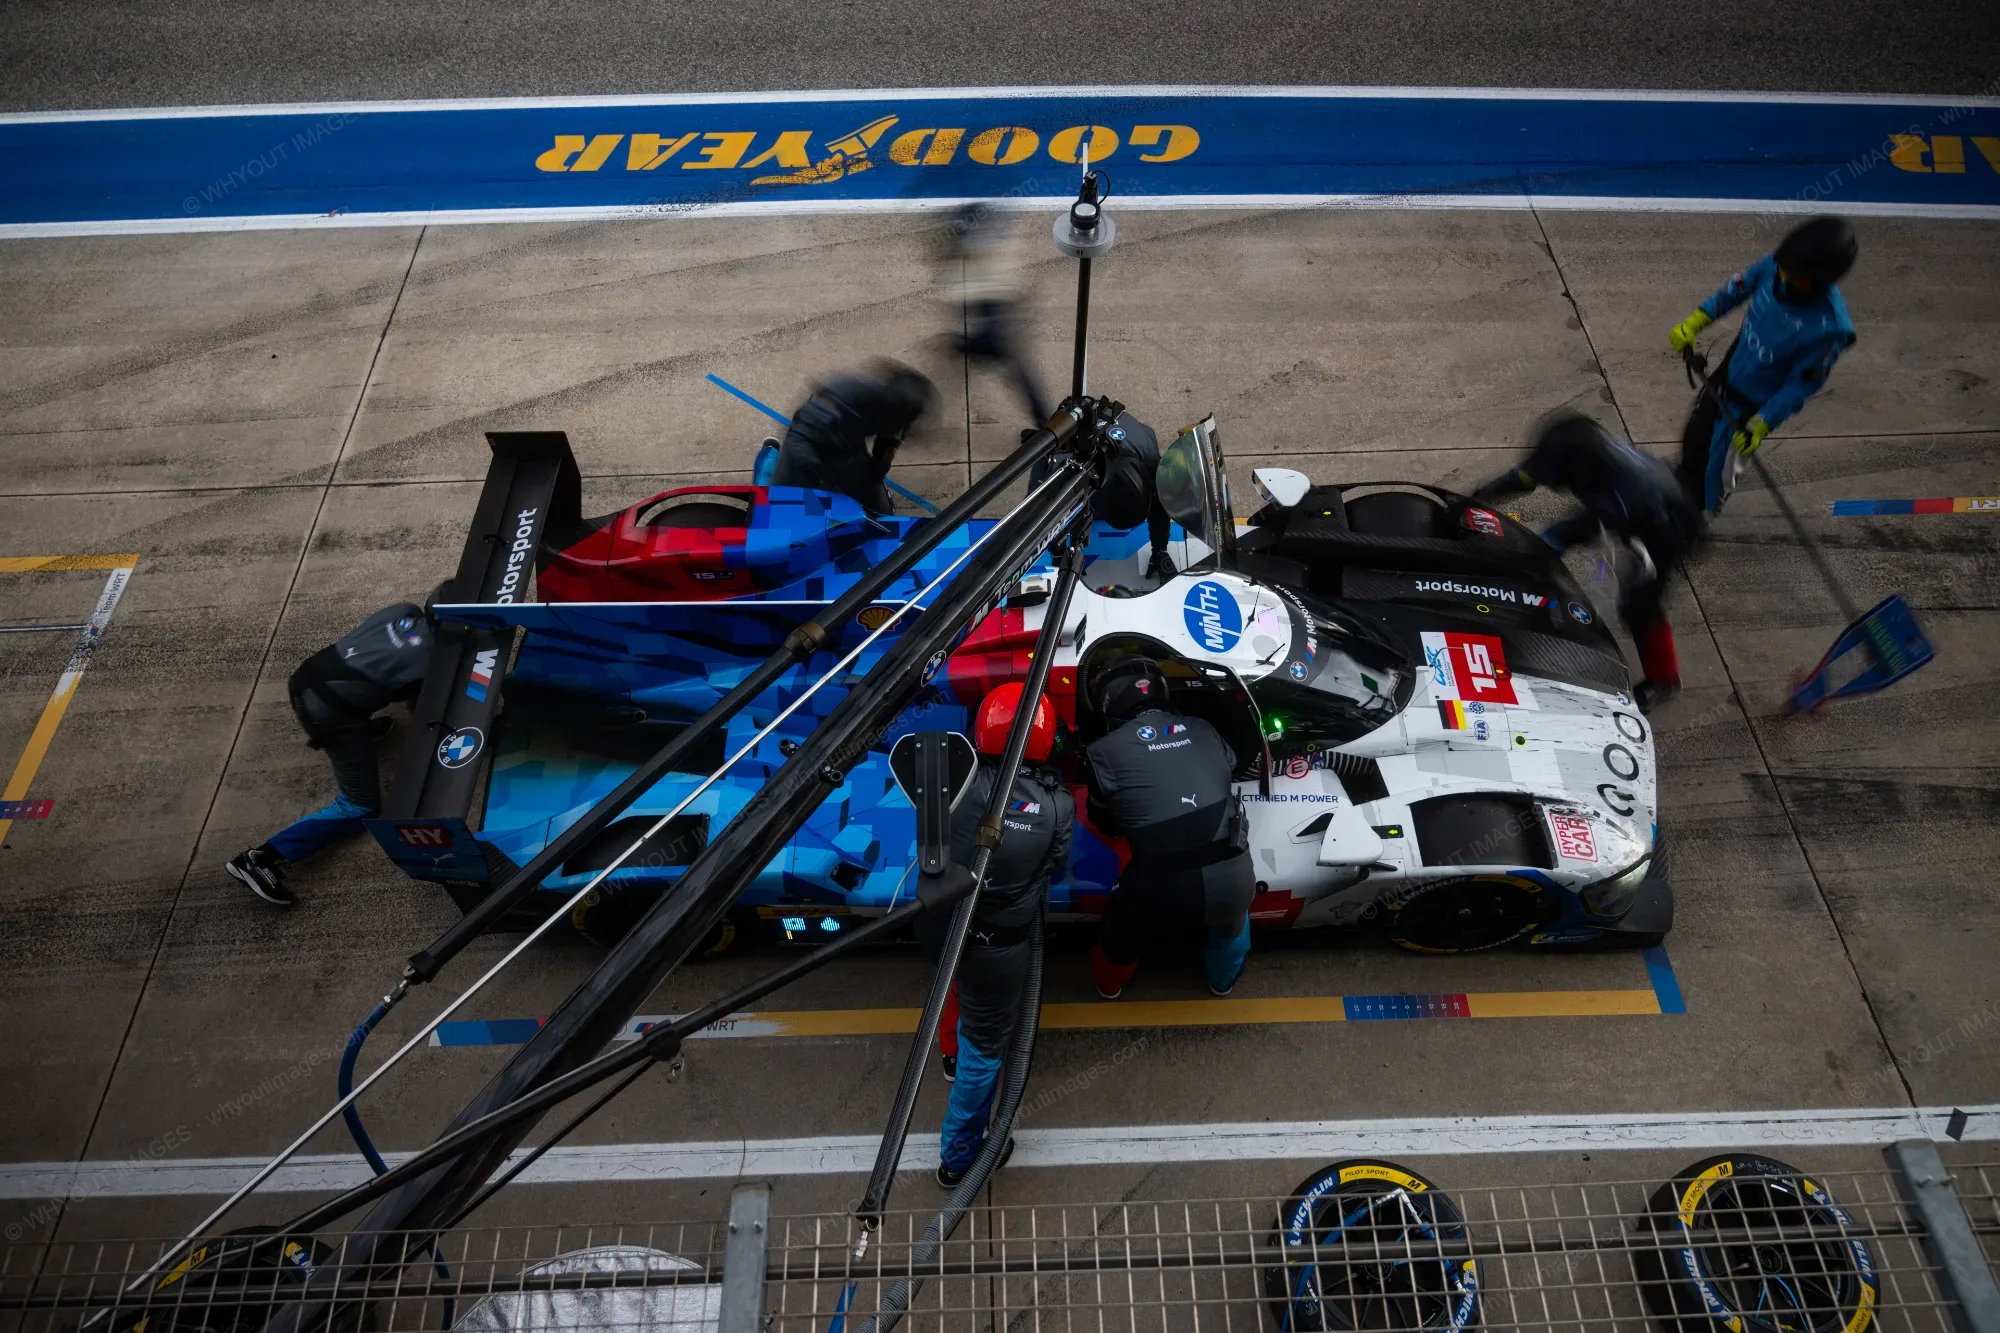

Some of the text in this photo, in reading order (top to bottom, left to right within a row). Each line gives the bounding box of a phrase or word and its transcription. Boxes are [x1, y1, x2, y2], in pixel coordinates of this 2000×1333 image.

[535, 124, 1200, 173] GOODYEAR
[497, 508, 537, 604] otorsport
[112, 572, 125, 592] WRT
[1416, 580, 1516, 602] Motorsport
[1274, 584, 1316, 634] Motorsport
[1463, 643, 1497, 693] 15
[1148, 738, 1191, 751] Motorsport
[1302, 794, 1338, 803] POWER
[401, 828, 444, 845] HY
[1557, 816, 1576, 856] HYPER
[1568, 817, 1594, 858] CAR
[706, 1020, 737, 1031] WRT
[1344, 1168, 1422, 1190] PILOT SPORT M
[1717, 1163, 1730, 1176] M
[1691, 1183, 1703, 1198] SPOR
[1293, 1176, 1334, 1236] MICHELIN
